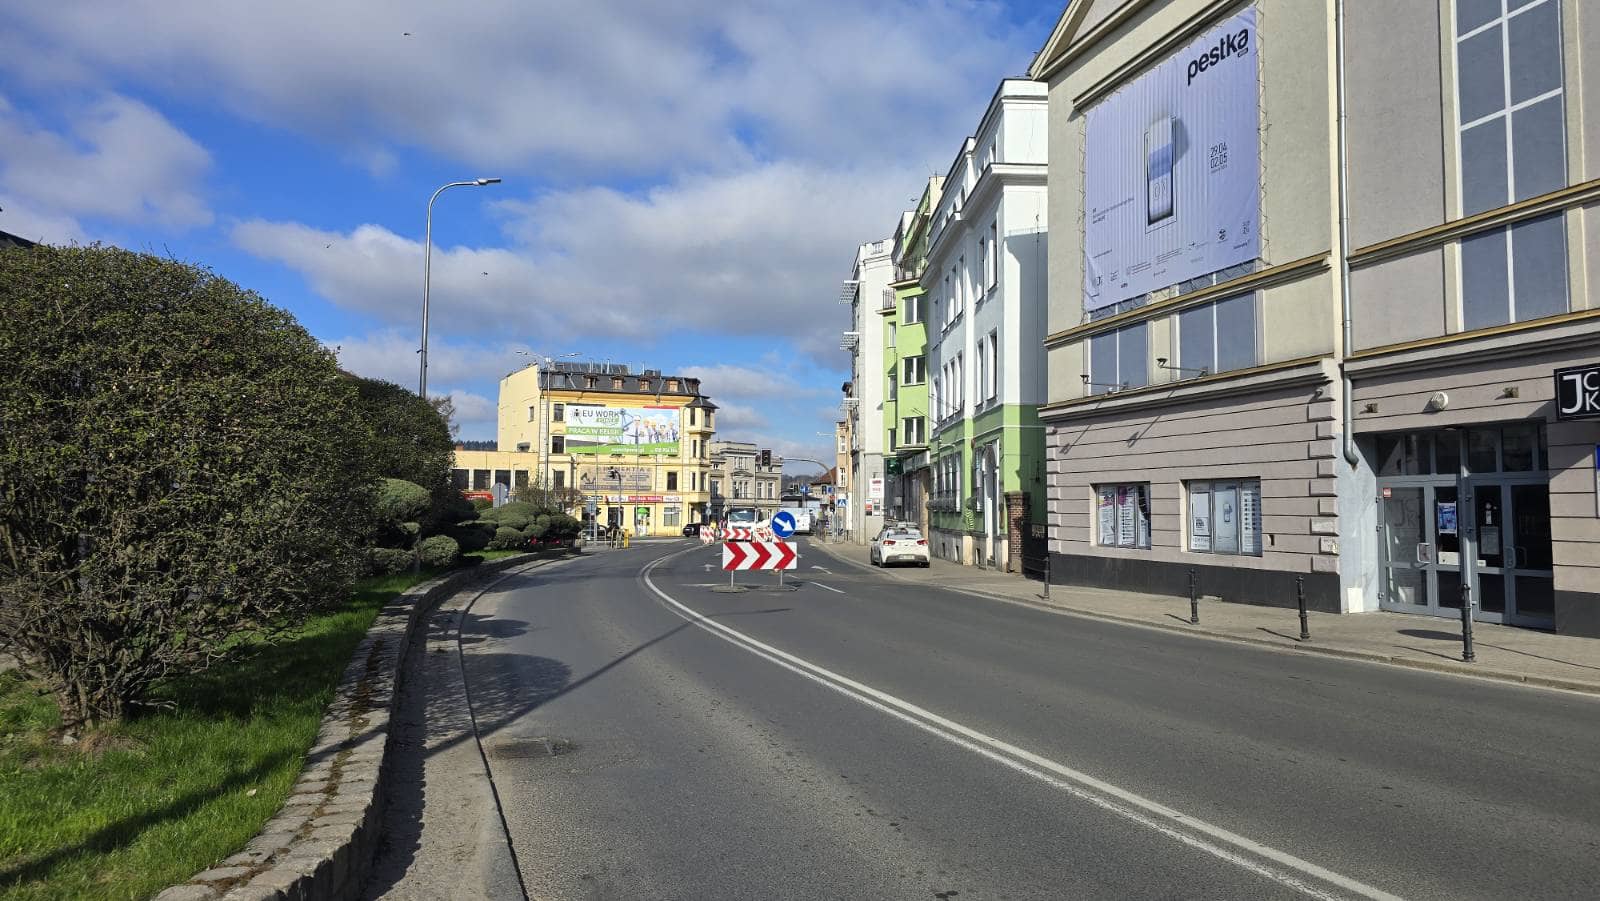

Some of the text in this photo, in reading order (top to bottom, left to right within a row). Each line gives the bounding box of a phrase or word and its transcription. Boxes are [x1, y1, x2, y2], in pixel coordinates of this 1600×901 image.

[1187, 28, 1249, 86] pestka
[582, 409, 620, 418] EU WORK
